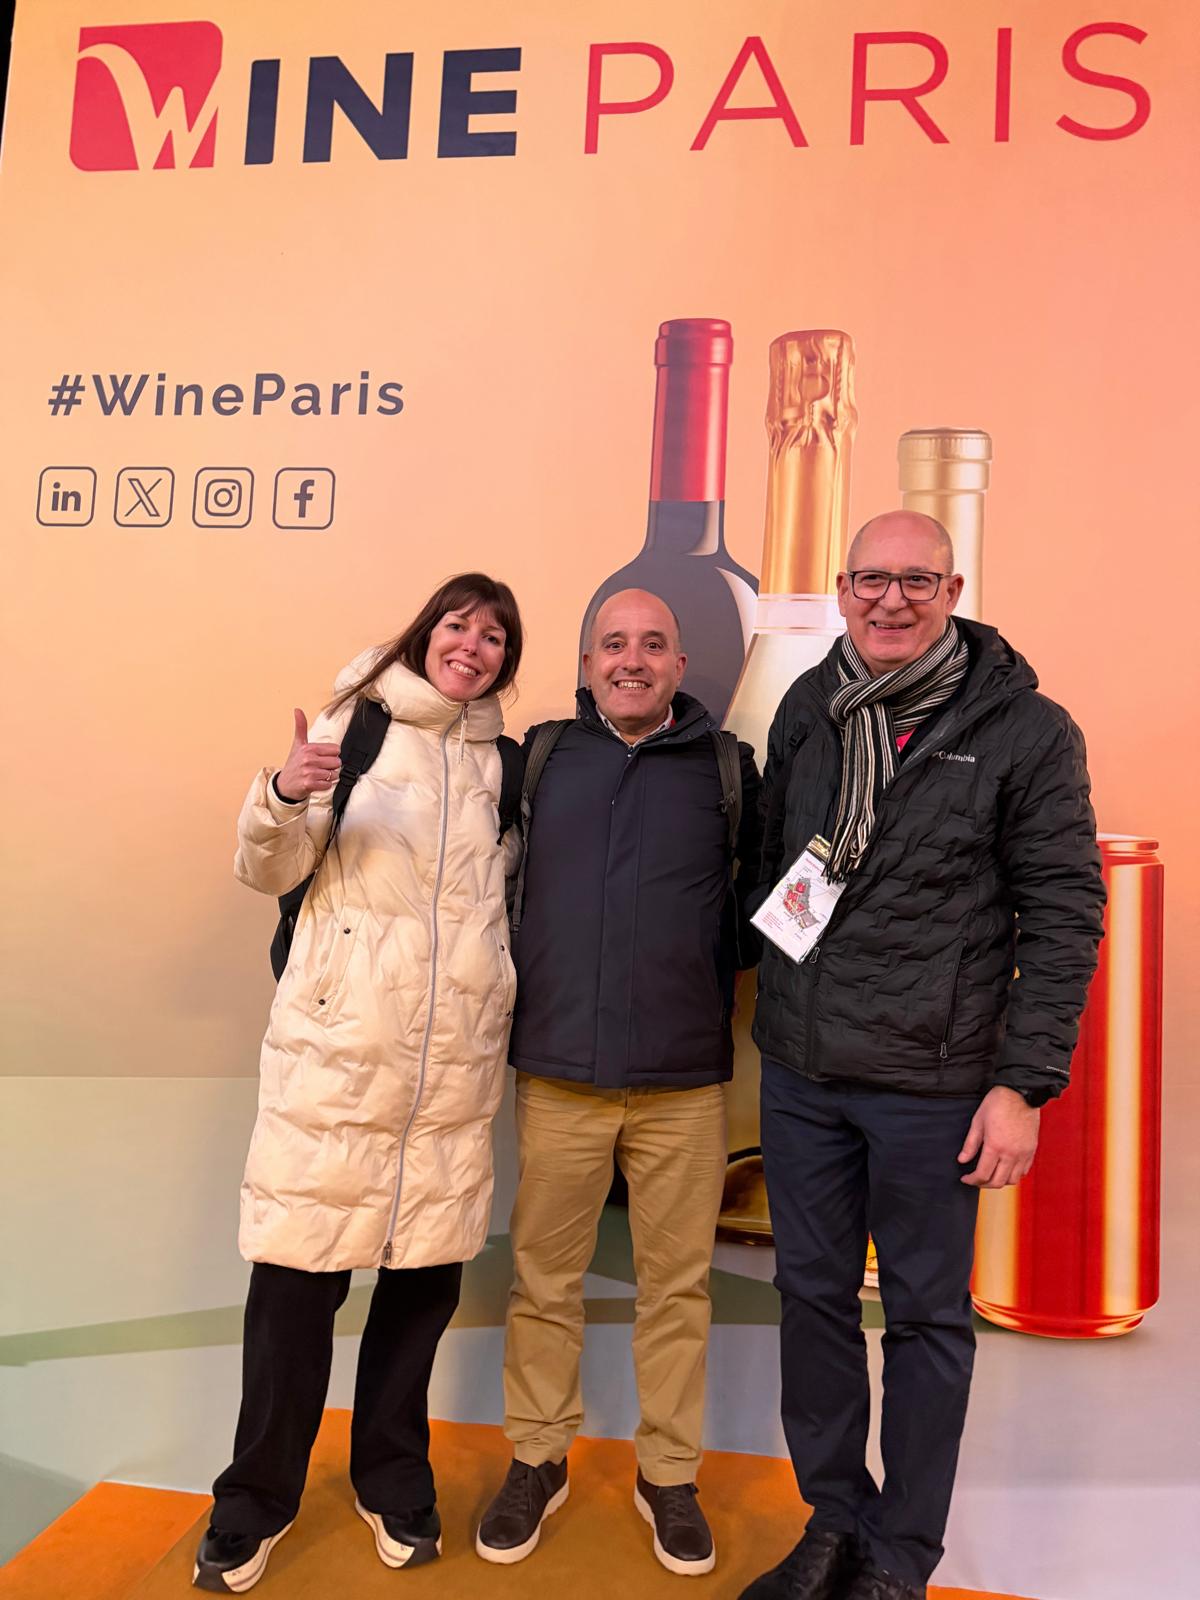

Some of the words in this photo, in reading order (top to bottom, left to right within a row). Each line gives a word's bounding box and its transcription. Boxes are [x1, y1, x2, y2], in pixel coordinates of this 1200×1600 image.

[76, 43, 522, 170] WINE
[584, 22, 1151, 154] PARIS
[48, 371, 405, 416] #WineParis
[938, 750, 976, 763] Columbia
